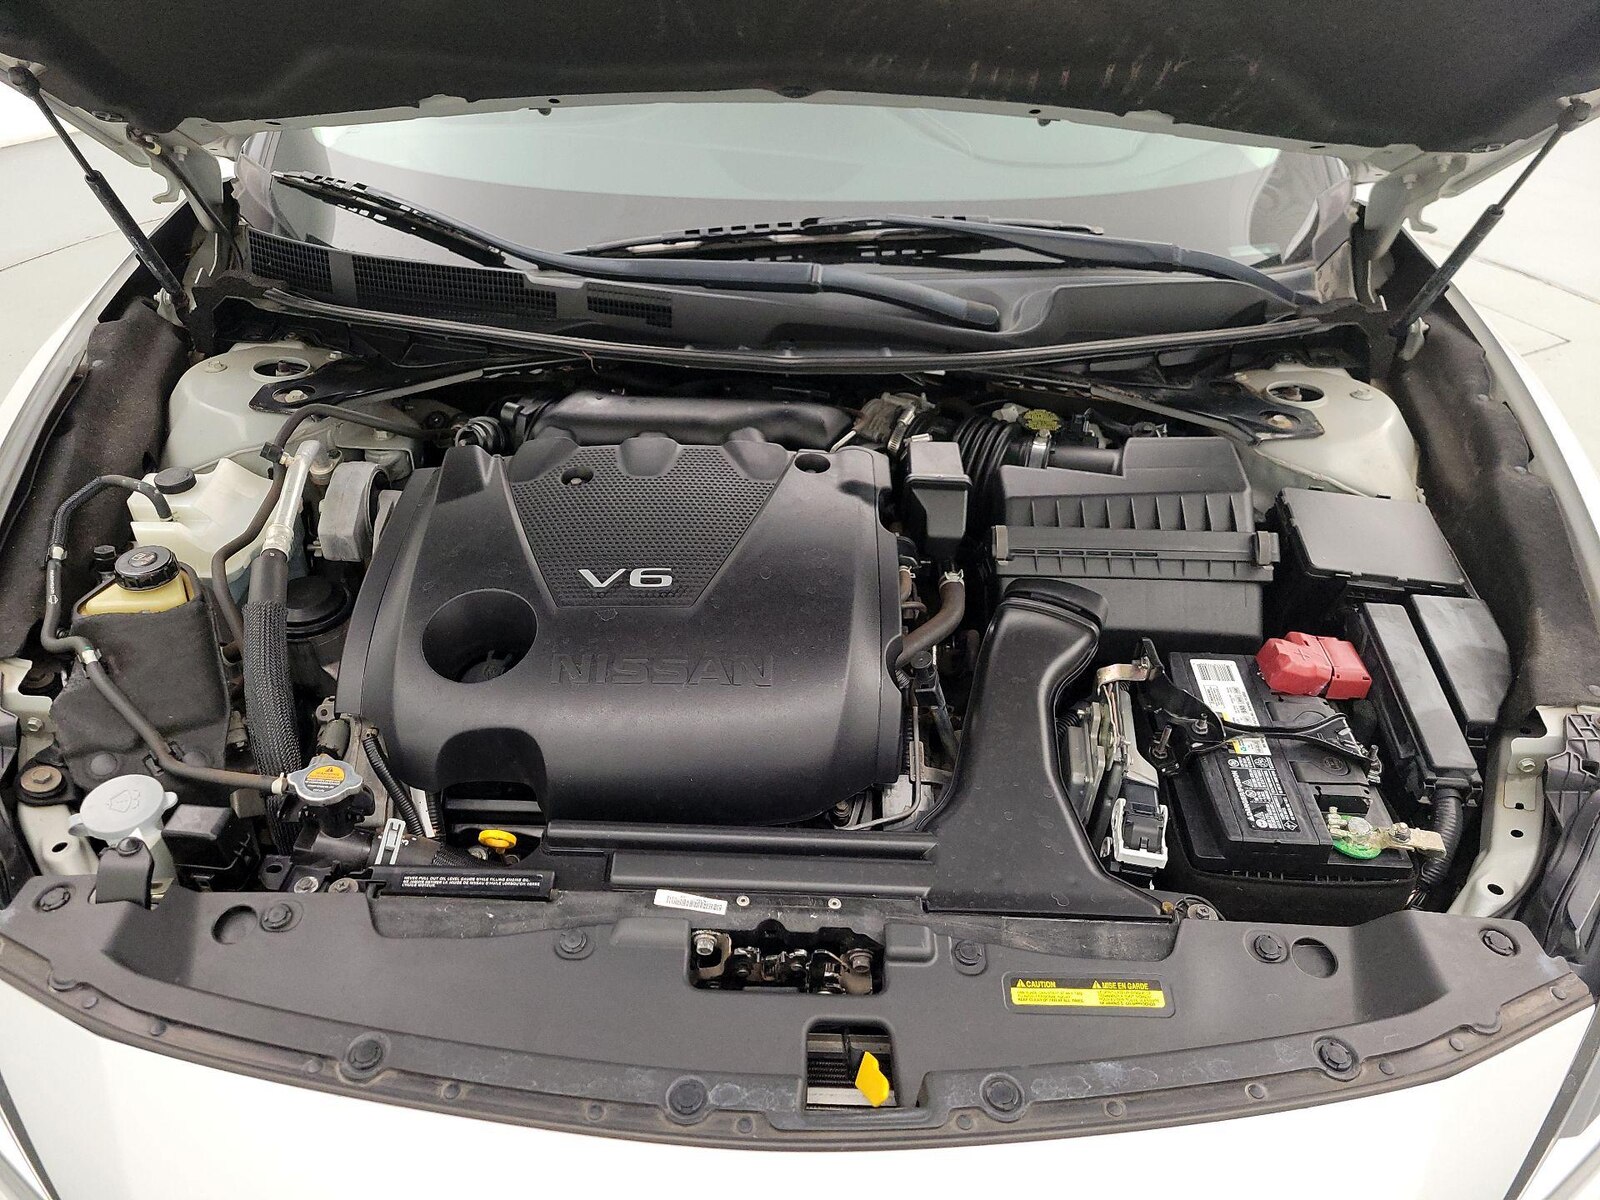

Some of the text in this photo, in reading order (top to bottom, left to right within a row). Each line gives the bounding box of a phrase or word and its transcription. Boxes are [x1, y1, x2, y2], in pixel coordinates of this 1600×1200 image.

[578, 568, 673, 588] V6
[551, 653, 772, 687] NISSAN
[1026, 980, 1056, 988] CAUTION
[1102, 981, 1117, 989] MISE
[1127, 982, 1149, 990] GARDE
